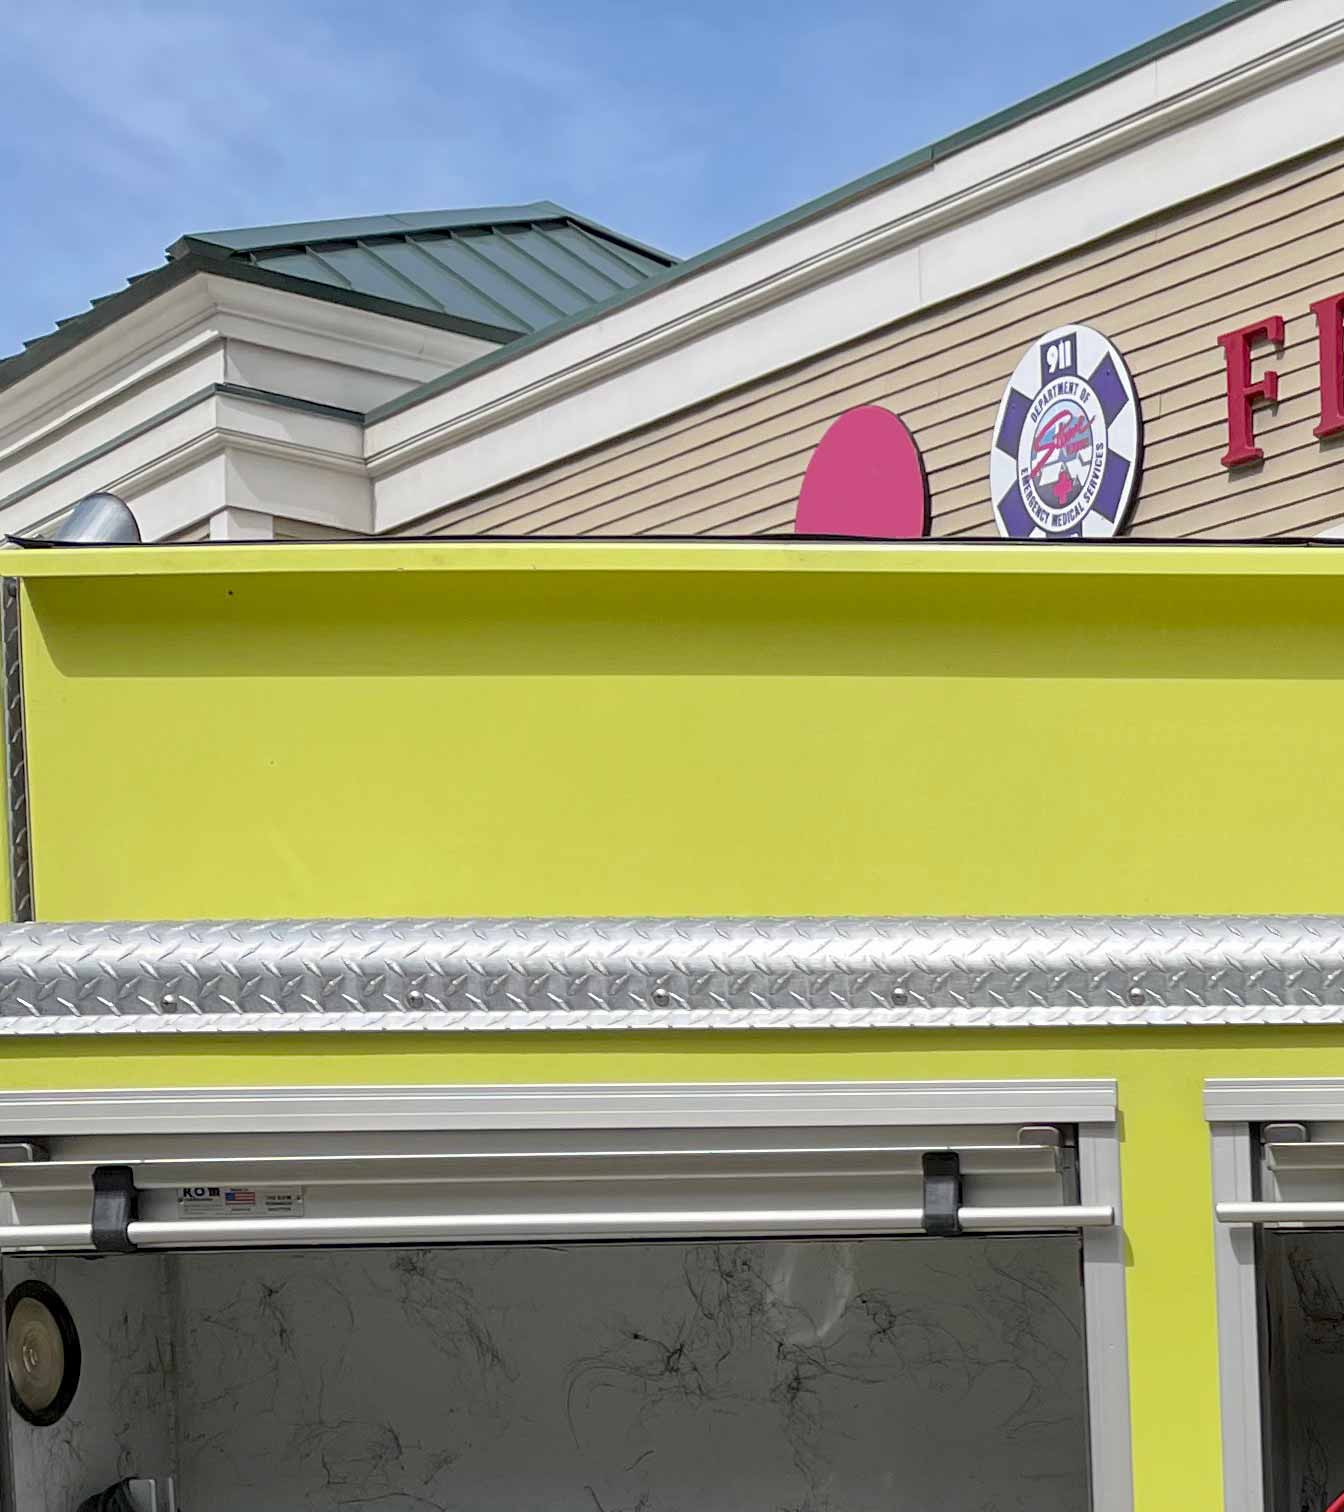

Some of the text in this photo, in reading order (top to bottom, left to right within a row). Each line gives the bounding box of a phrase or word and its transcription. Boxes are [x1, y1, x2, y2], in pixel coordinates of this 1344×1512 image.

[1046, 340, 1072, 374] 911
[1030, 381, 1091, 424] DEPARTMENT OF
[1020, 442, 1105, 528] EMERGENCY MEDICAL SERVICES
